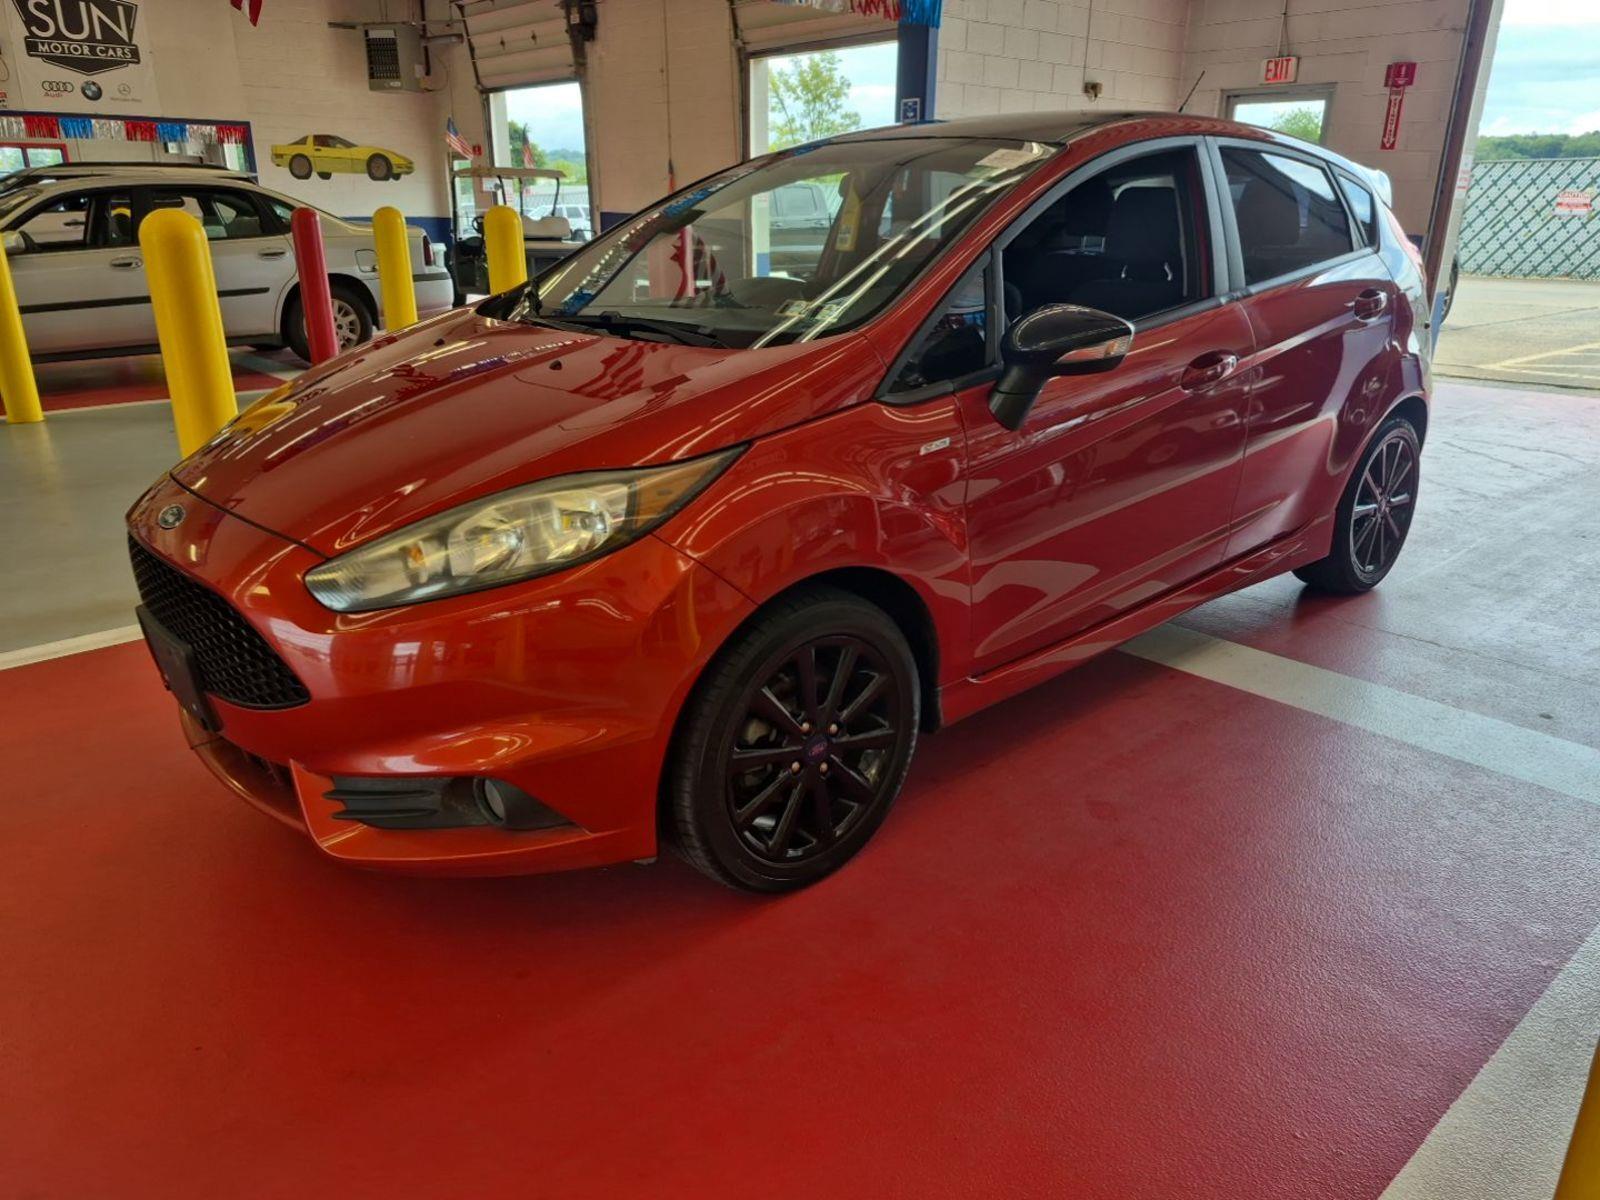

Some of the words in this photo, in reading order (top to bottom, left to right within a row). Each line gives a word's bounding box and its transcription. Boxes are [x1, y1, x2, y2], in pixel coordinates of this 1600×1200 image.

[27, 0, 130, 43] SUN
[38, 43, 91, 56] MOTOR
[96, 47, 132, 59] CARS
[1265, 59, 1291, 81] EXIT
